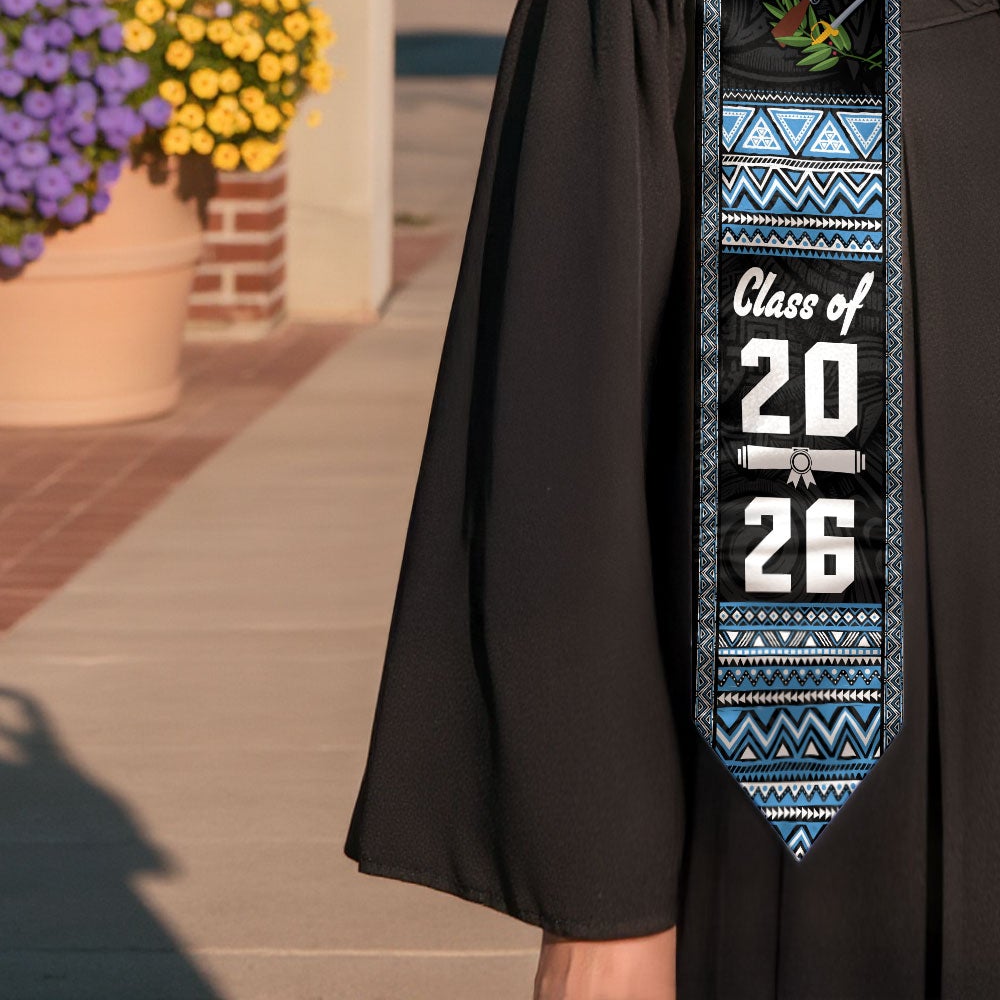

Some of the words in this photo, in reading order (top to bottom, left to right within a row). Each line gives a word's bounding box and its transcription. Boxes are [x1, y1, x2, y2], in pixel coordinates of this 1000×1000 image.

[733, 266, 819, 320] Class
[826, 270, 875, 336] of
[740, 337, 859, 438] 20
[744, 496, 855, 594] 26
